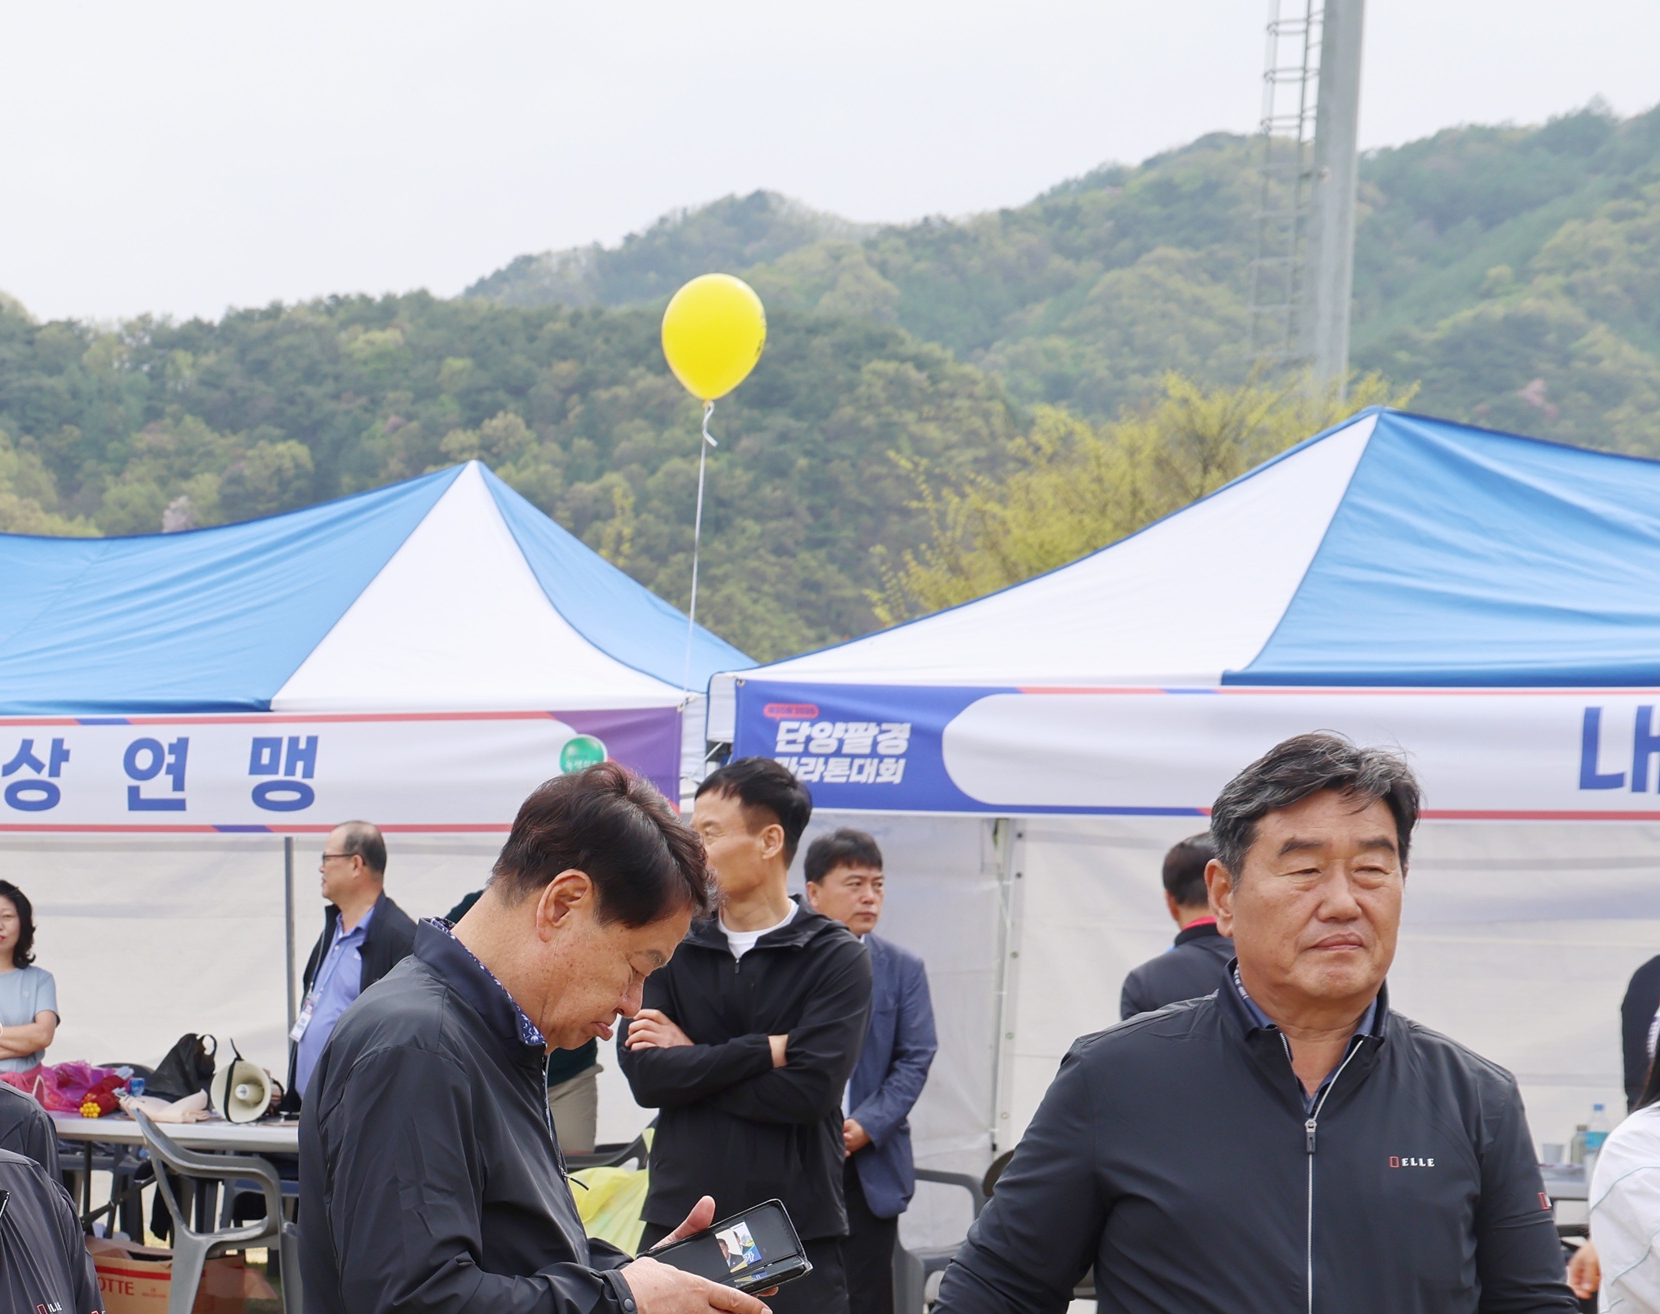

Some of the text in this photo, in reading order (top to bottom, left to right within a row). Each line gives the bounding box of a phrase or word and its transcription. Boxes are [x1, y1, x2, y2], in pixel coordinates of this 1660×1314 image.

[774, 720, 912, 755] 단양팔경
[1401, 1157, 1435, 1168] ELLE
[97, 1276, 135, 1296] OTTE
